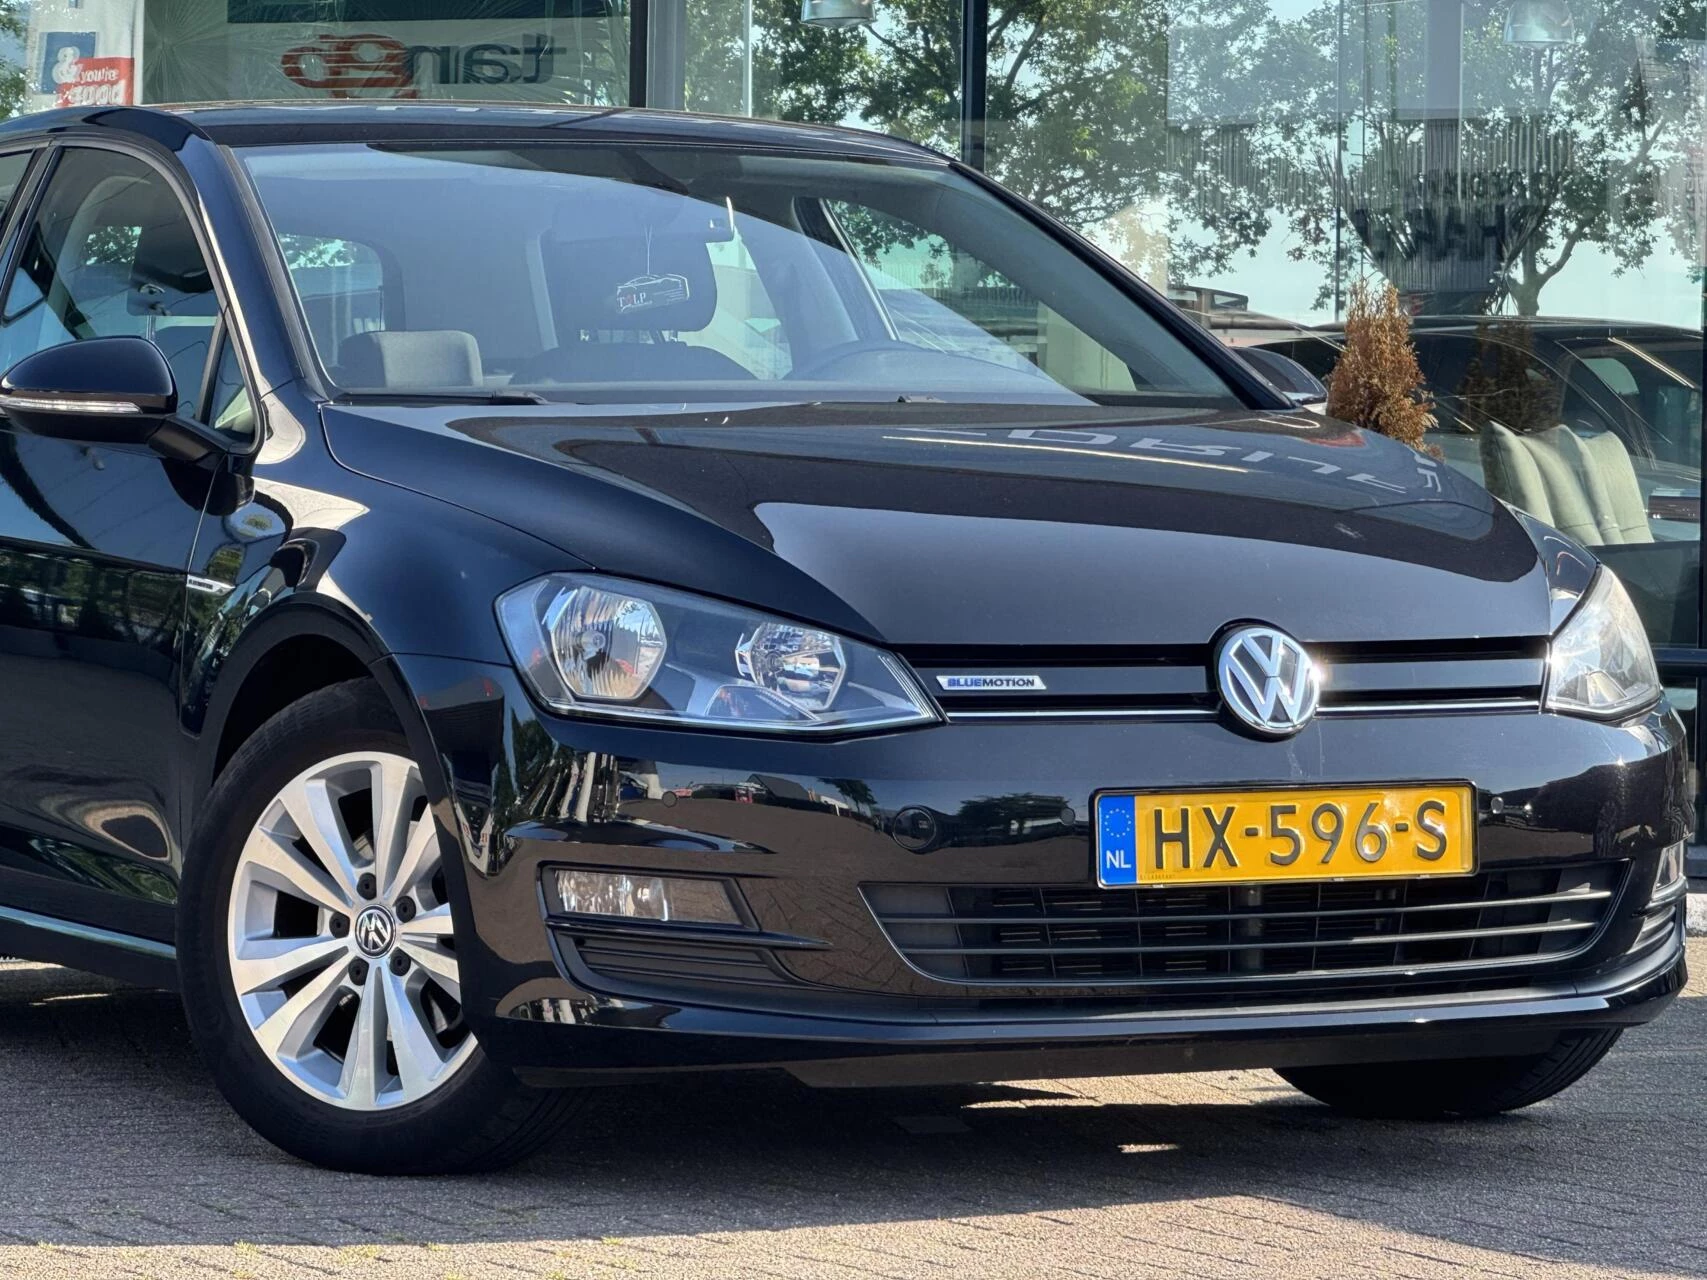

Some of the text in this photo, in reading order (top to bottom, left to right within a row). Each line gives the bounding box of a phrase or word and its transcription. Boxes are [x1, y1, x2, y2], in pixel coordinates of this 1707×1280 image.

[947, 677, 1035, 688] BLUEMOTION
[1153, 801, 1447, 869] HX-596-S
[1105, 850, 1132, 869] NL
